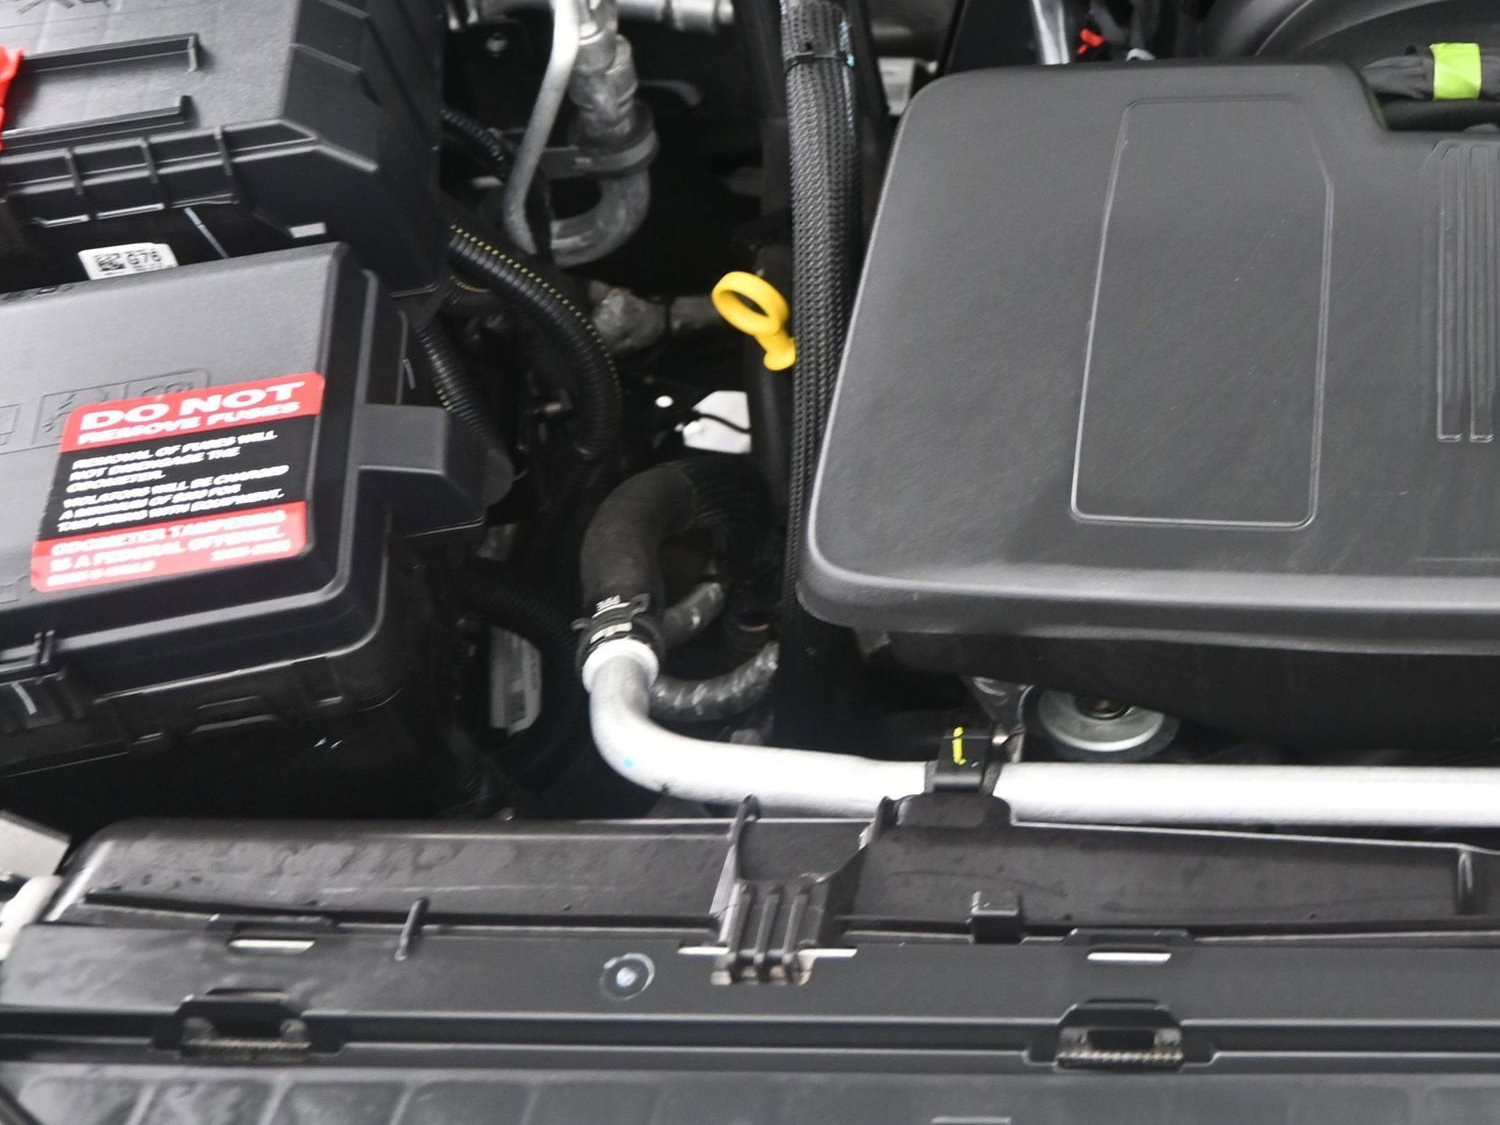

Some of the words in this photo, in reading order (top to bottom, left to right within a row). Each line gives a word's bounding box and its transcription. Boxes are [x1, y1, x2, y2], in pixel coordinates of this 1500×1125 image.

[78, 416, 200, 445] REMOVE
[207, 402, 299, 425] FUSES
[80, 403, 169, 430] DO
[180, 382, 304, 416] NOT
